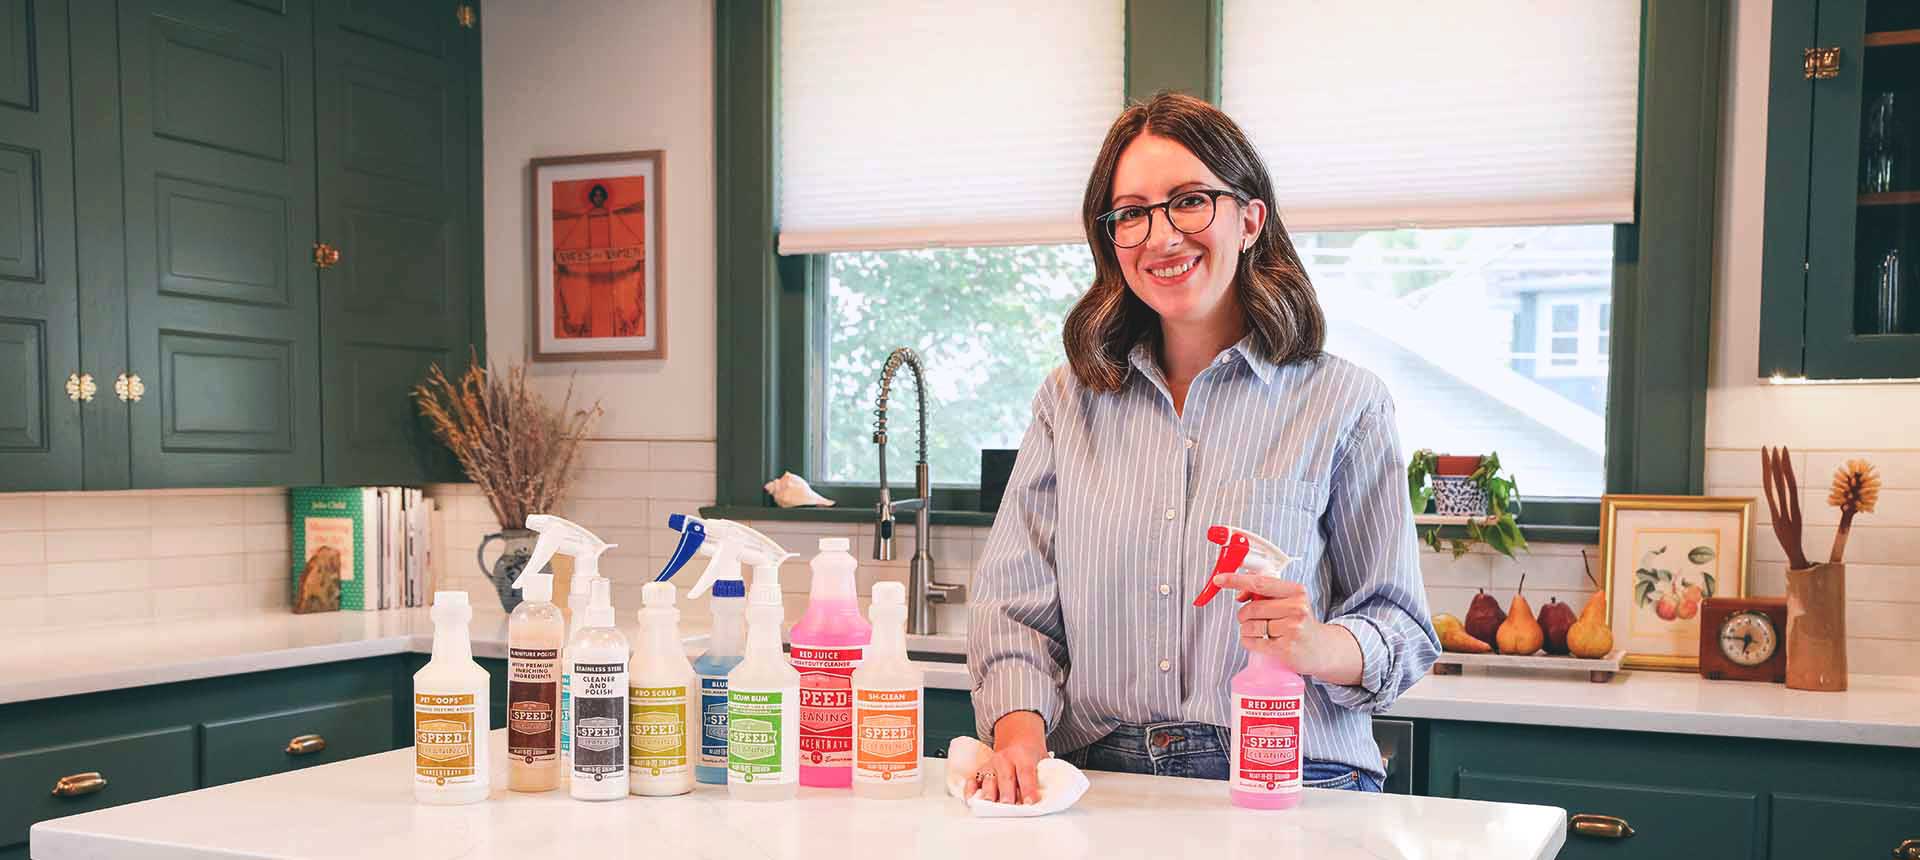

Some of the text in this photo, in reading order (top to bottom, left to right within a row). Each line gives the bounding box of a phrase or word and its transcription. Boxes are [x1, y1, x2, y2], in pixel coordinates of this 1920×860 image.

[800, 650, 839, 659] RED JUICE
[576, 665, 606, 673] STAINLESS
[635, 689, 648, 697] PRO
[868, 693, 906, 701] SH-CLEAN
[432, 696, 464, 705] "OOPS"
[800, 690, 848, 706] PEED
[1248, 701, 1296, 709] RED JUICE
[513, 711, 548, 720] SPEED
[800, 711, 848, 722] EANING
[581, 728, 615, 737] SPEED
[634, 725, 675, 735] SPEED
[866, 728, 908, 738] SPEED
[422, 733, 462, 743] SPEED
[734, 732, 768, 742] SPEED
[1250, 737, 1292, 748] SPEED
